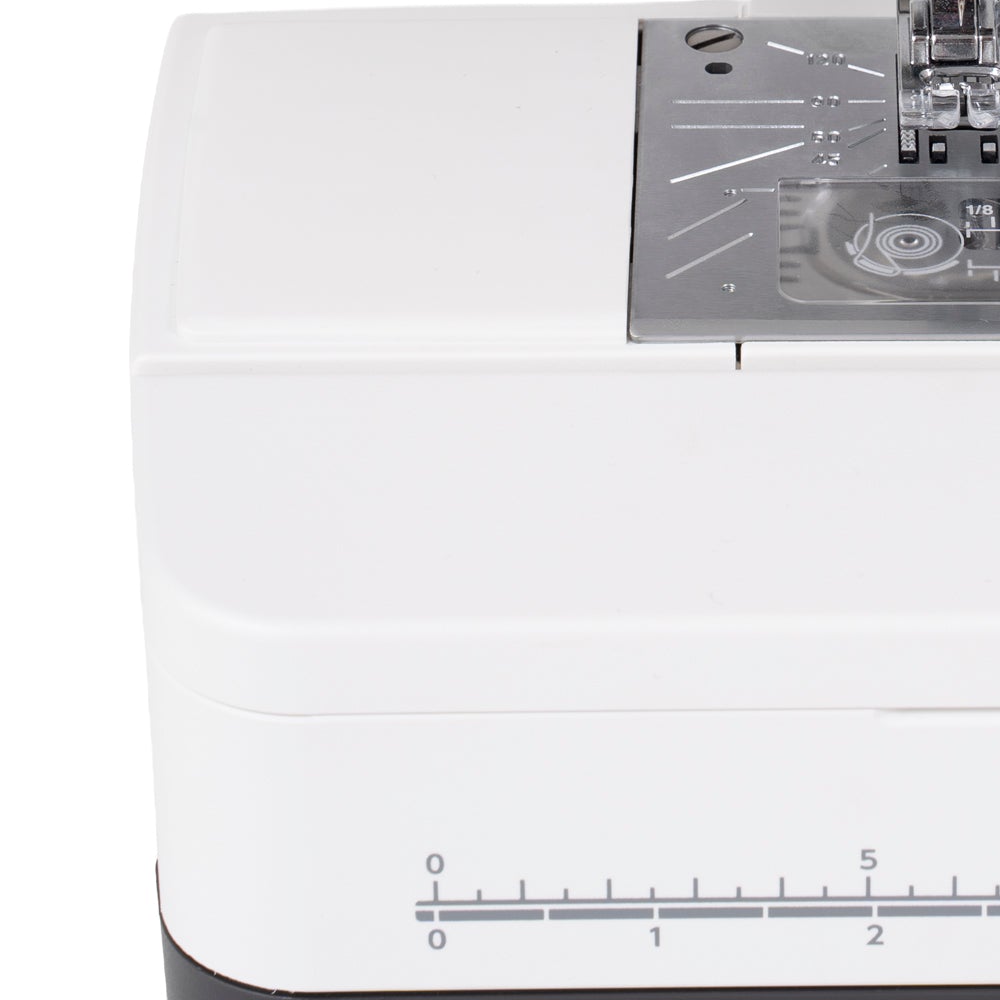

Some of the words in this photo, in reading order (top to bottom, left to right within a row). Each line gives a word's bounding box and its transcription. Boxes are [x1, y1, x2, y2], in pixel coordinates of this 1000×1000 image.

[965, 204, 994, 216] 1/8
[425, 852, 445, 875] 0
[859, 848, 878, 871] 5
[427, 928, 447, 951] 0
[649, 926, 661, 948] 1
[866, 923, 885, 946] 2
